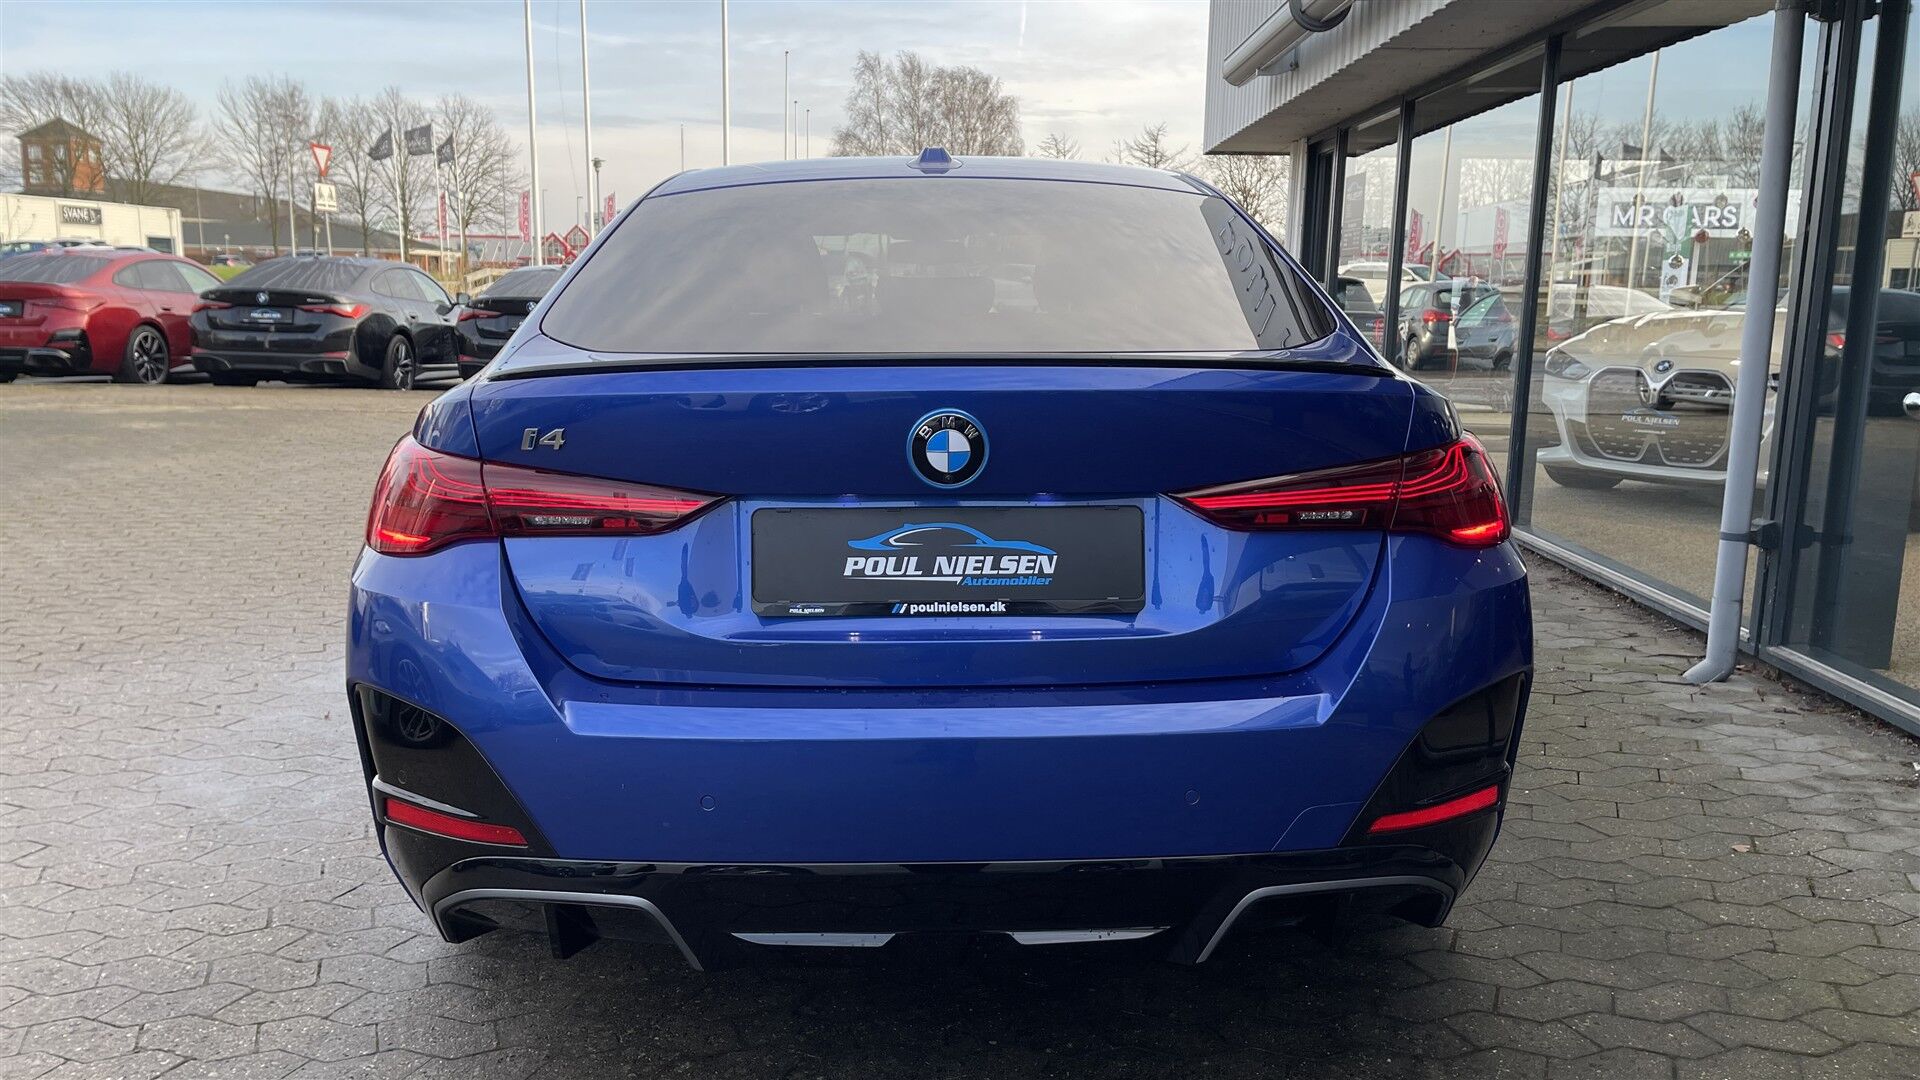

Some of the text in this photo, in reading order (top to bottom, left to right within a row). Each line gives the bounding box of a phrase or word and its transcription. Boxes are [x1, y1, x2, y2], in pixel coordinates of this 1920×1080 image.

[1612, 204, 1655, 227] MR
[918, 415, 980, 441] BMW
[520, 428, 566, 451] i4
[843, 555, 1058, 576] POUL NIELSEN
[961, 575, 1053, 586] Automobiler
[910, 602, 1007, 615] poulnielsen.dk
